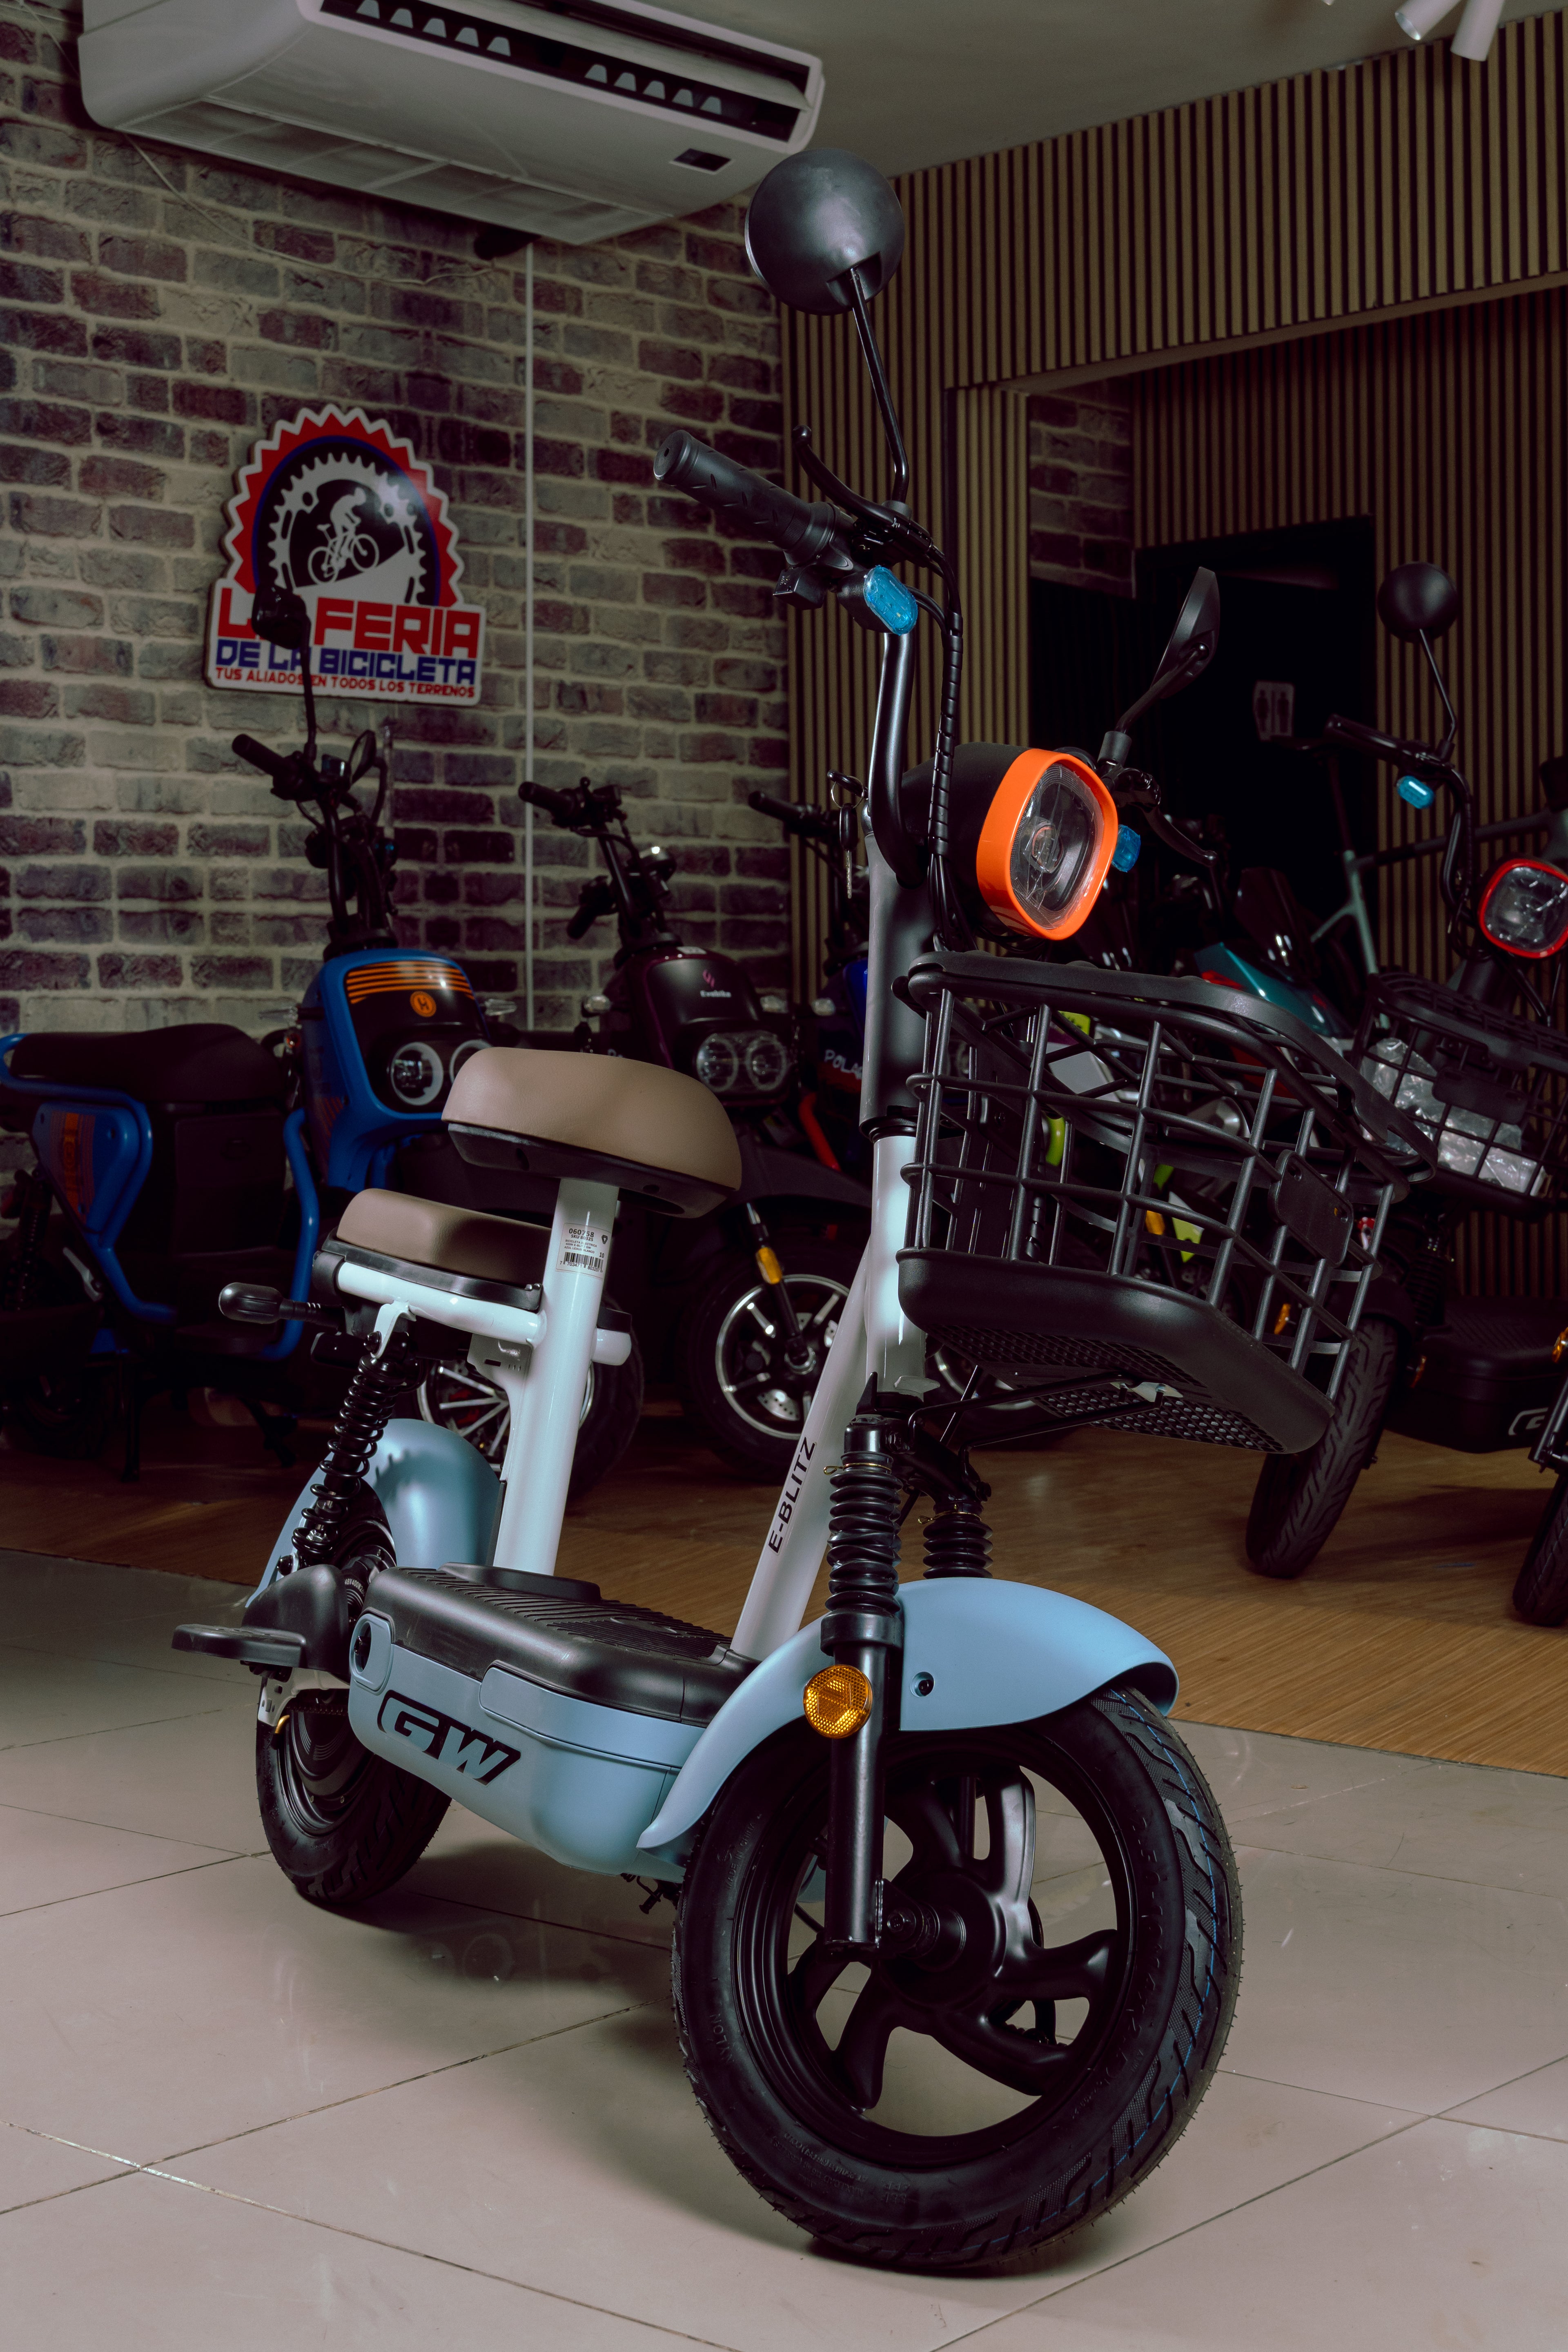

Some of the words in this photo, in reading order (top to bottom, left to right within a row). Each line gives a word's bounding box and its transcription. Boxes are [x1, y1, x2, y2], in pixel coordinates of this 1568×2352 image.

[314, 597, 479, 658] FERIA
[216, 639, 261, 668] DE
[320, 648, 476, 685] BICICLETA
[216, 667, 242, 680] TUS
[310, 675, 327, 686] EN
[332, 676, 375, 691] TODOS
[379, 679, 404, 693] LOS
[410, 682, 475, 698] TERRENOS
[569, 1228, 595, 1238] 060758
[768, 1436, 816, 1554] E-BLITZ
[377, 1689, 521, 1786] GW
[726, 1863, 737, 1889] MADE
[709, 2013, 735, 2063] NYLON
